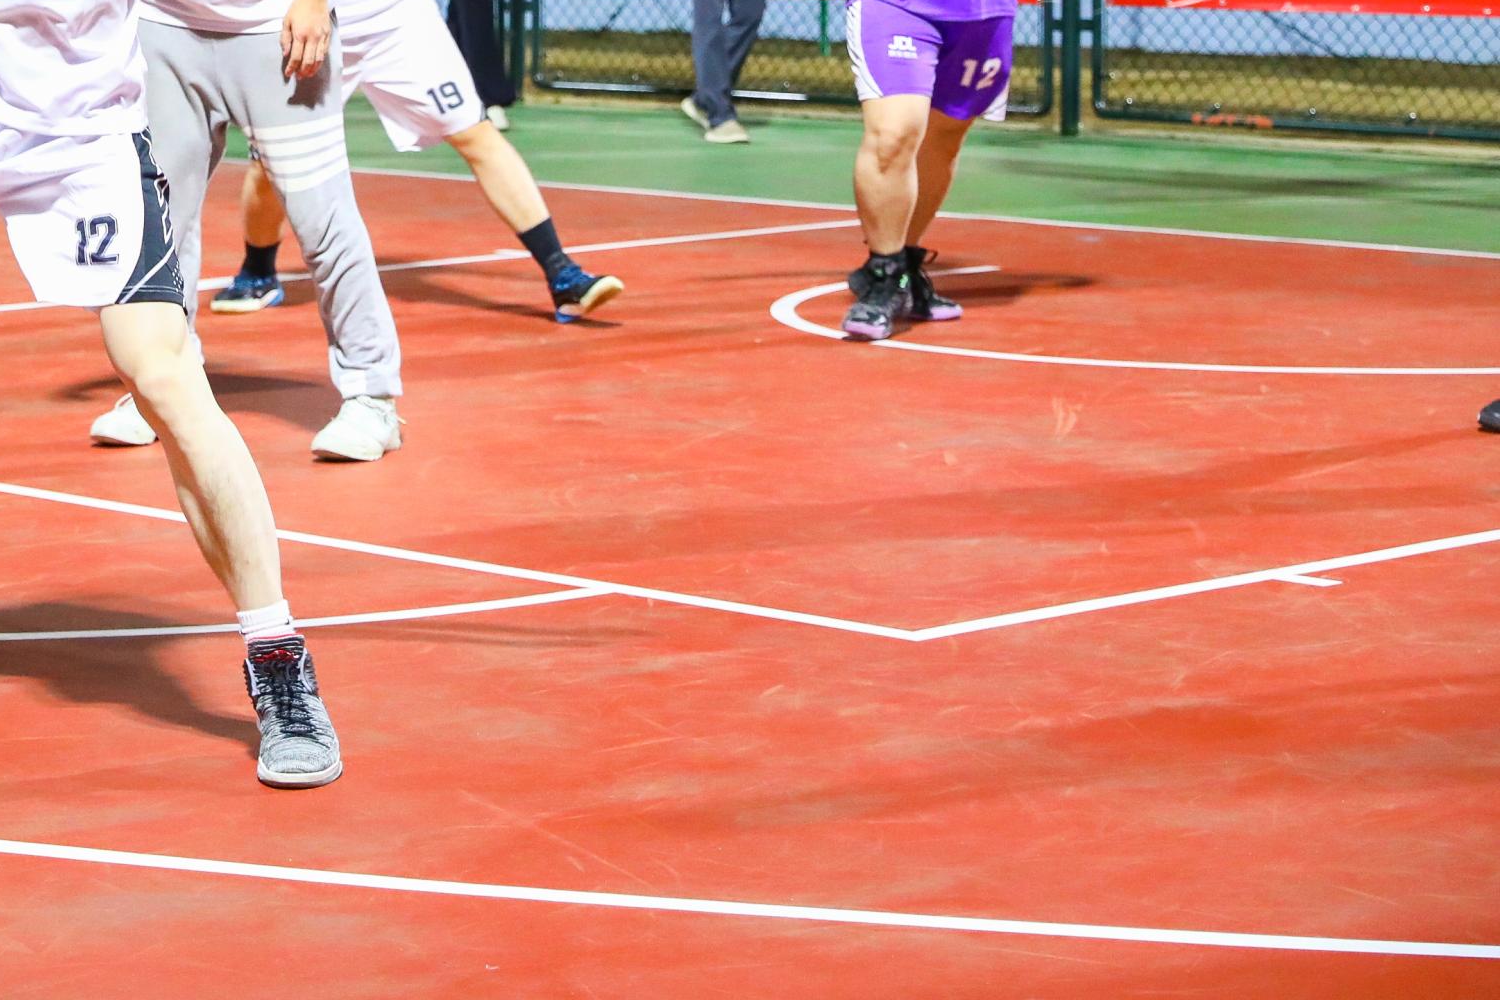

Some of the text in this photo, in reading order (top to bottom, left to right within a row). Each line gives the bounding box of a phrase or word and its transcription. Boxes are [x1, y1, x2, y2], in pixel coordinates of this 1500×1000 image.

[961, 57, 1001, 91] 12
[427, 81, 464, 114] 19
[75, 213, 119, 266] 12
